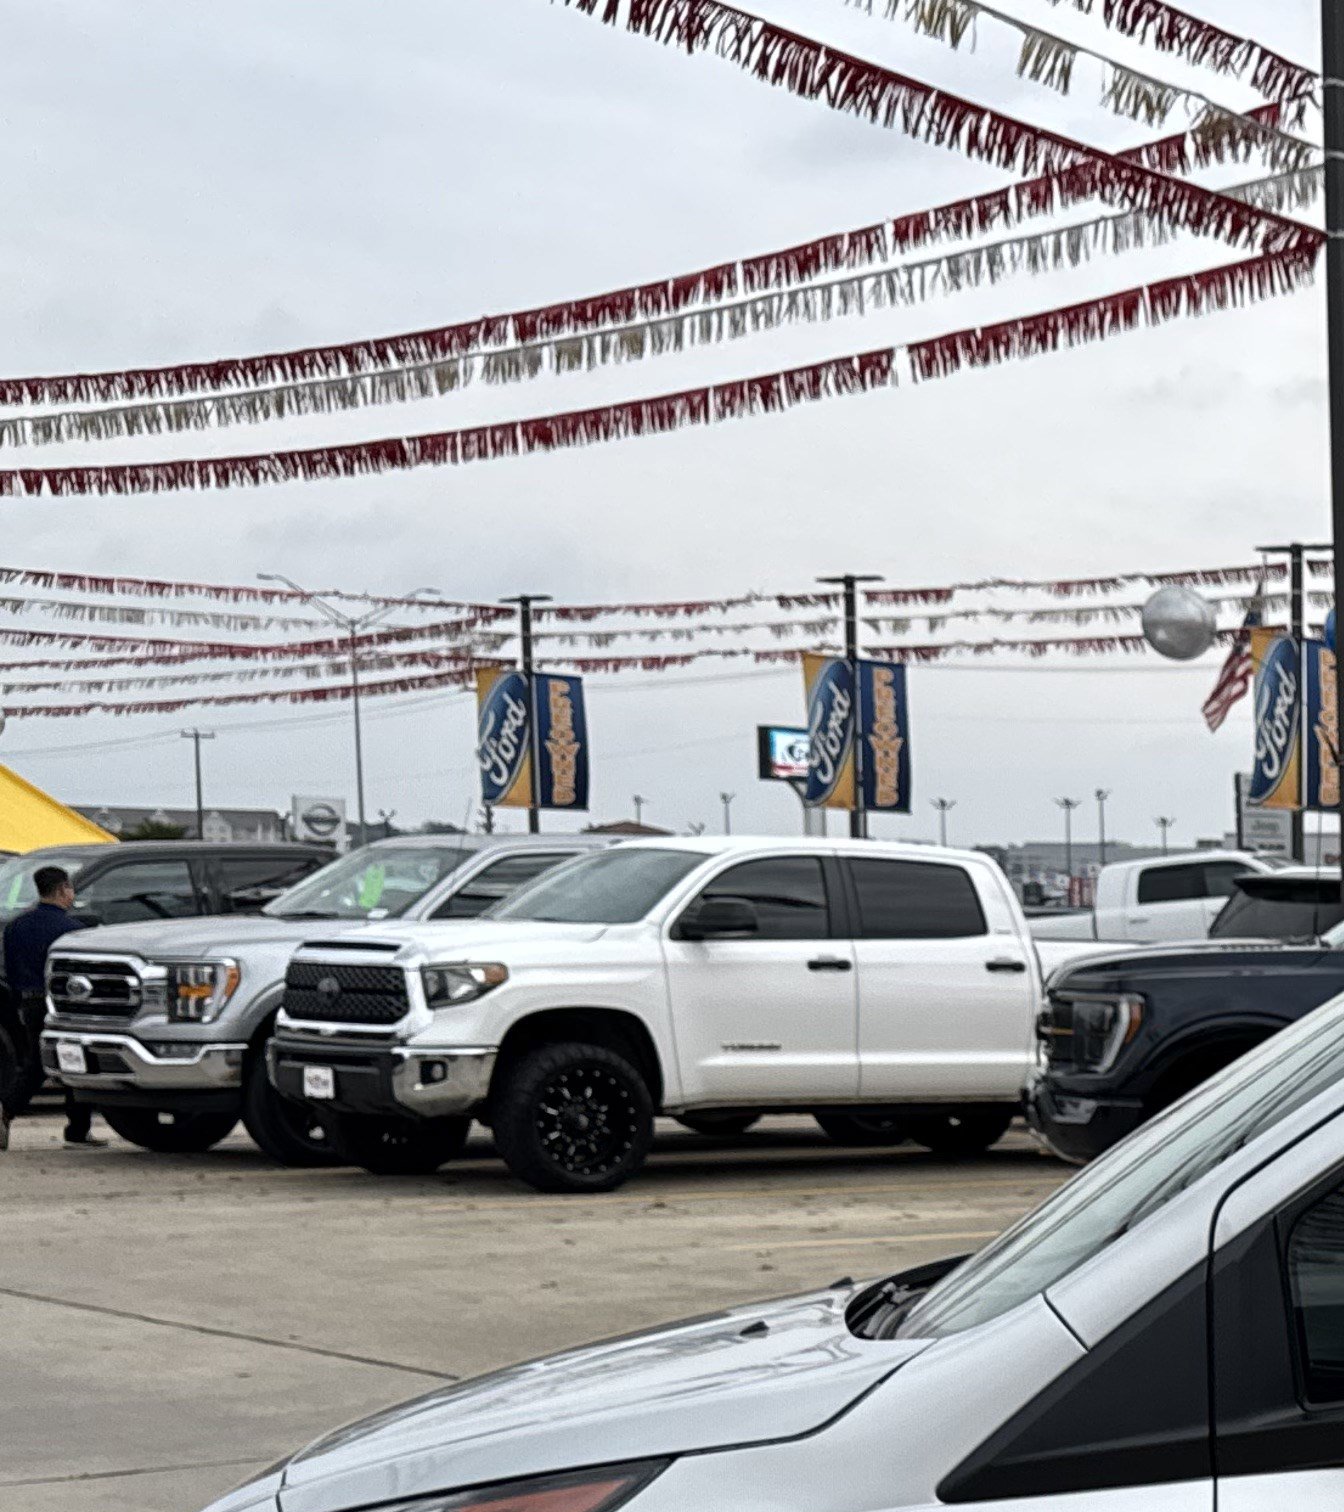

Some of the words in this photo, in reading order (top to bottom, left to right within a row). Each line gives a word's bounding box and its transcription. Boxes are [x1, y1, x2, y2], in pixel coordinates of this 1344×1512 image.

[478, 691, 527, 787] Ford
[809, 680, 851, 785] Ford
[1256, 660, 1298, 779] Ford
